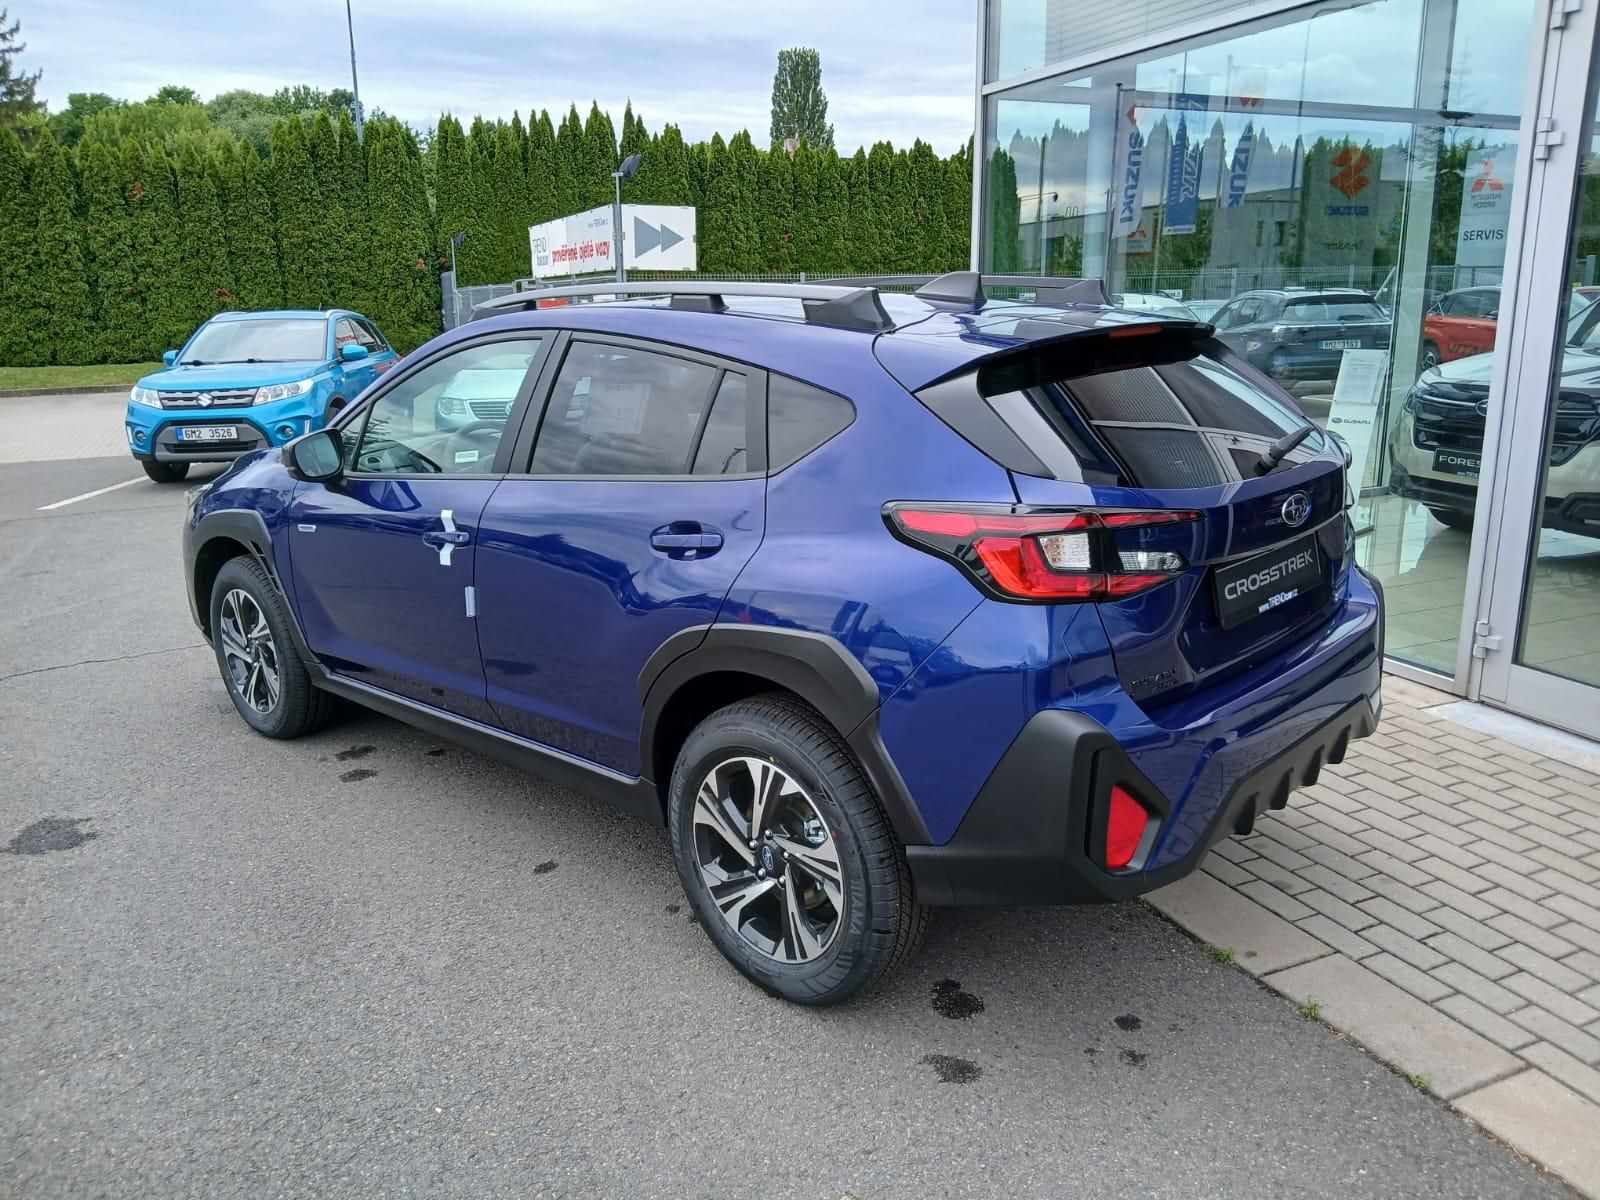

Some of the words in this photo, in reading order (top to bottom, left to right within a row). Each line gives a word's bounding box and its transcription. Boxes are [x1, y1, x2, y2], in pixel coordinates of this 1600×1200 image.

[1119, 131, 1143, 223] SUZUKI
[1463, 229, 1504, 241] SERVIS
[595, 240, 611, 260] vozy
[184, 429, 203, 440] 6M2
[208, 428, 233, 438] 3526
[1224, 548, 1313, 600] CROSSTREK
